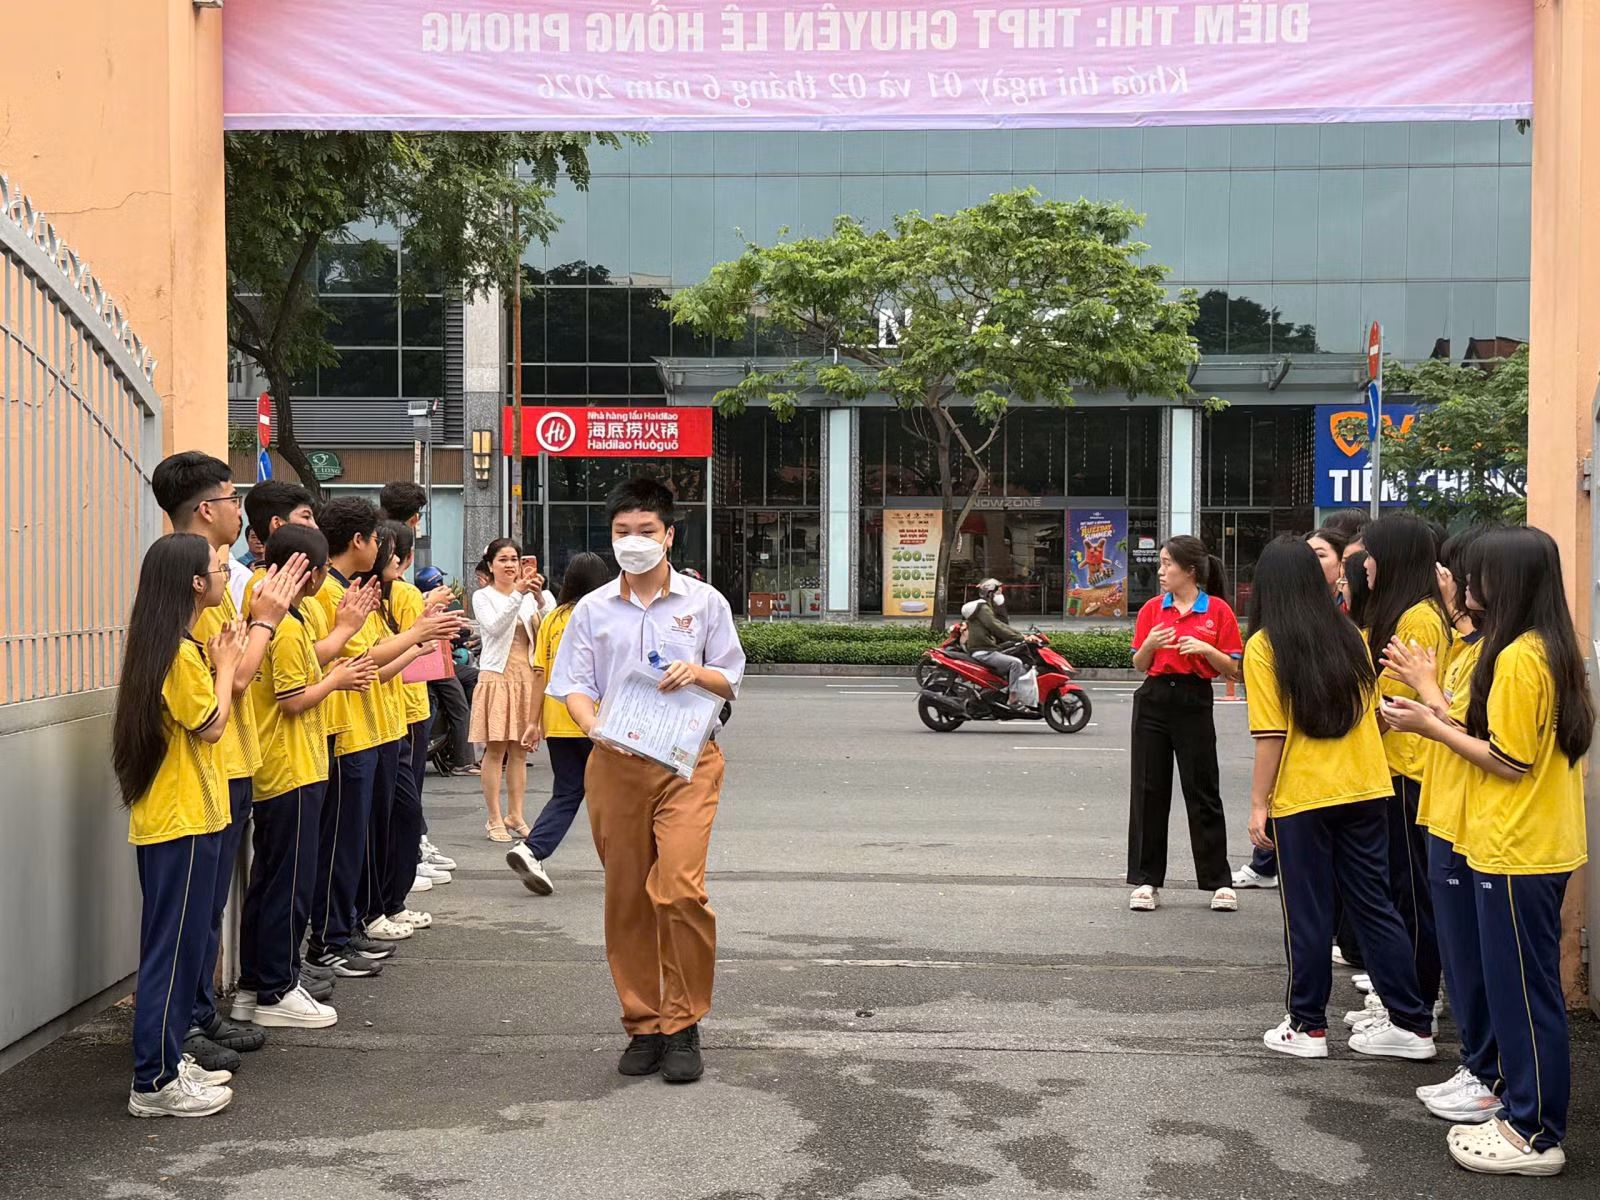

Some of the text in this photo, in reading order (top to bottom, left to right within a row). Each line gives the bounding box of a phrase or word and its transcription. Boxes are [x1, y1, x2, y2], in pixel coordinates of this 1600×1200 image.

[605, 411, 628, 422] hàng
[644, 411, 678, 420] Haidilao
[544, 419, 567, 444] Hi
[587, 422, 678, 439] 海底捞火锅
[587, 439, 632, 450] Haidilao
